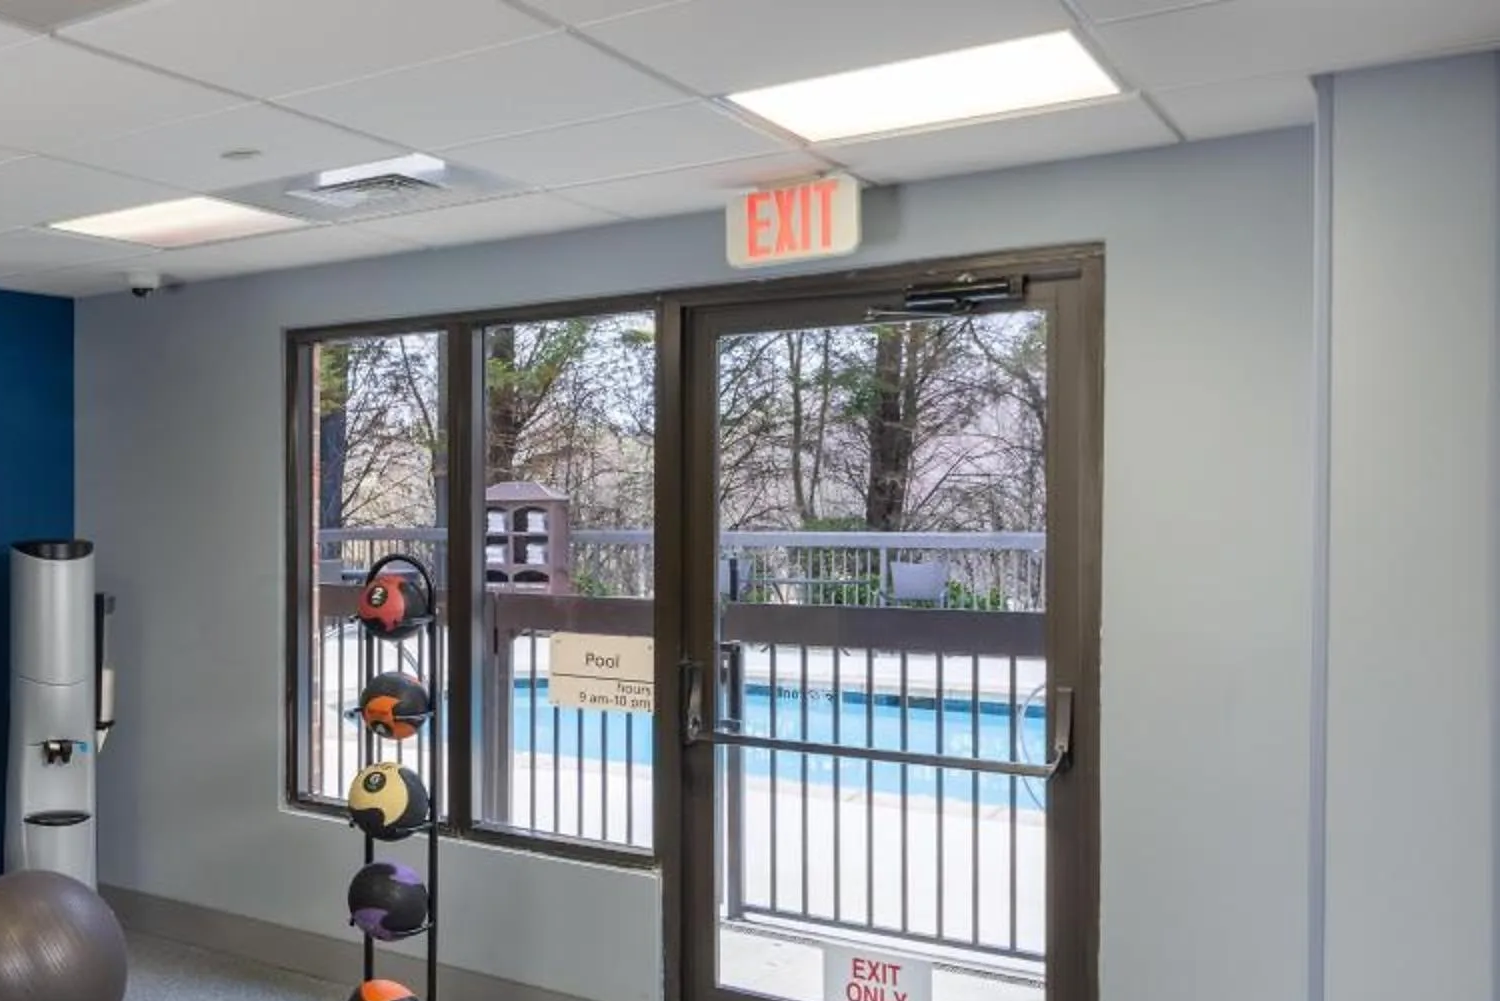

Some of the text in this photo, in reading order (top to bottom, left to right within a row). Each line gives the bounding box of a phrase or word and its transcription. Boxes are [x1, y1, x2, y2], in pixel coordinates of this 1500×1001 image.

[746, 177, 839, 258] EXIT
[585, 652, 620, 669] Pool
[851, 957, 903, 986] EXIT
